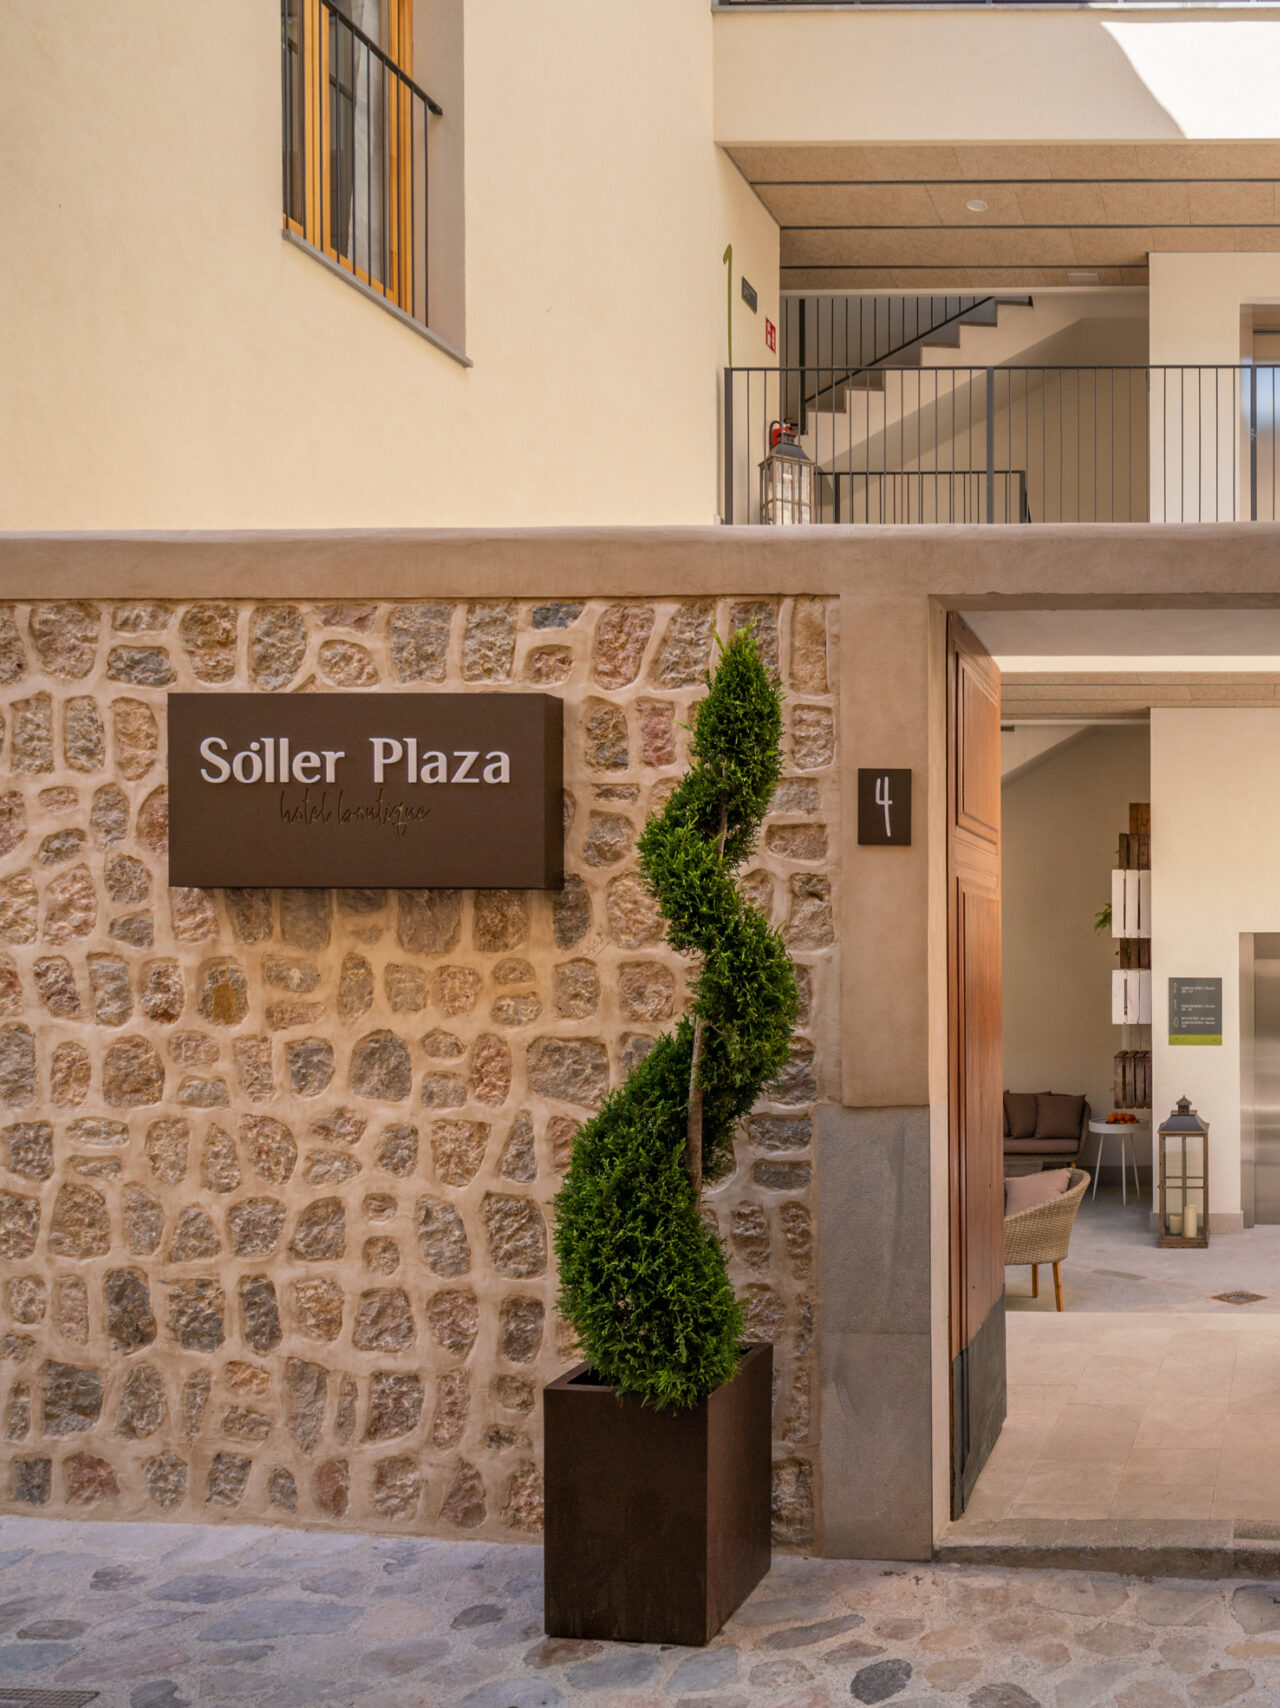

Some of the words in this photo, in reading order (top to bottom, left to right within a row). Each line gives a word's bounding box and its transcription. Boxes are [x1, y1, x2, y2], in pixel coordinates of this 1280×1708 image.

[368, 737, 510, 784] Plaza
[280, 787, 332, 825] hotel
[337, 787, 432, 838] boutique
[875, 776, 893, 837] 4
